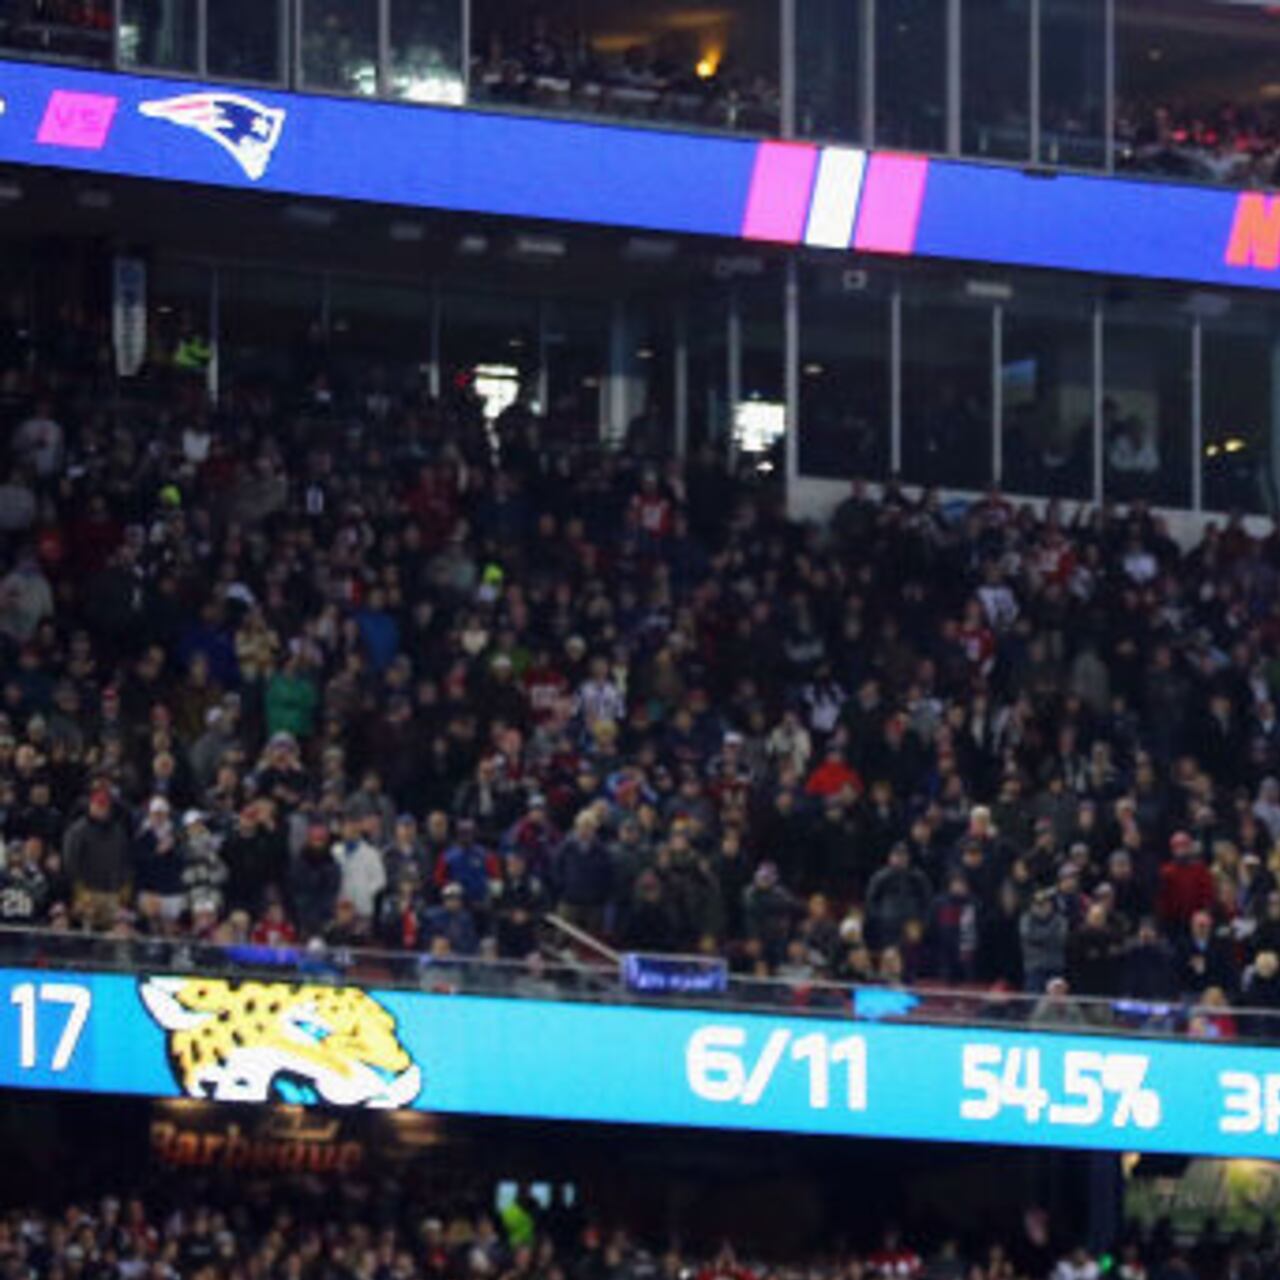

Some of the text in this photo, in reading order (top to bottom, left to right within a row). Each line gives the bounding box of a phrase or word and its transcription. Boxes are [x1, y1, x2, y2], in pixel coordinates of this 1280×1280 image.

[8, 982, 92, 1072] 17
[685, 1025, 869, 1112] 6/11
[960, 1044, 1162, 1130] 54.5%
